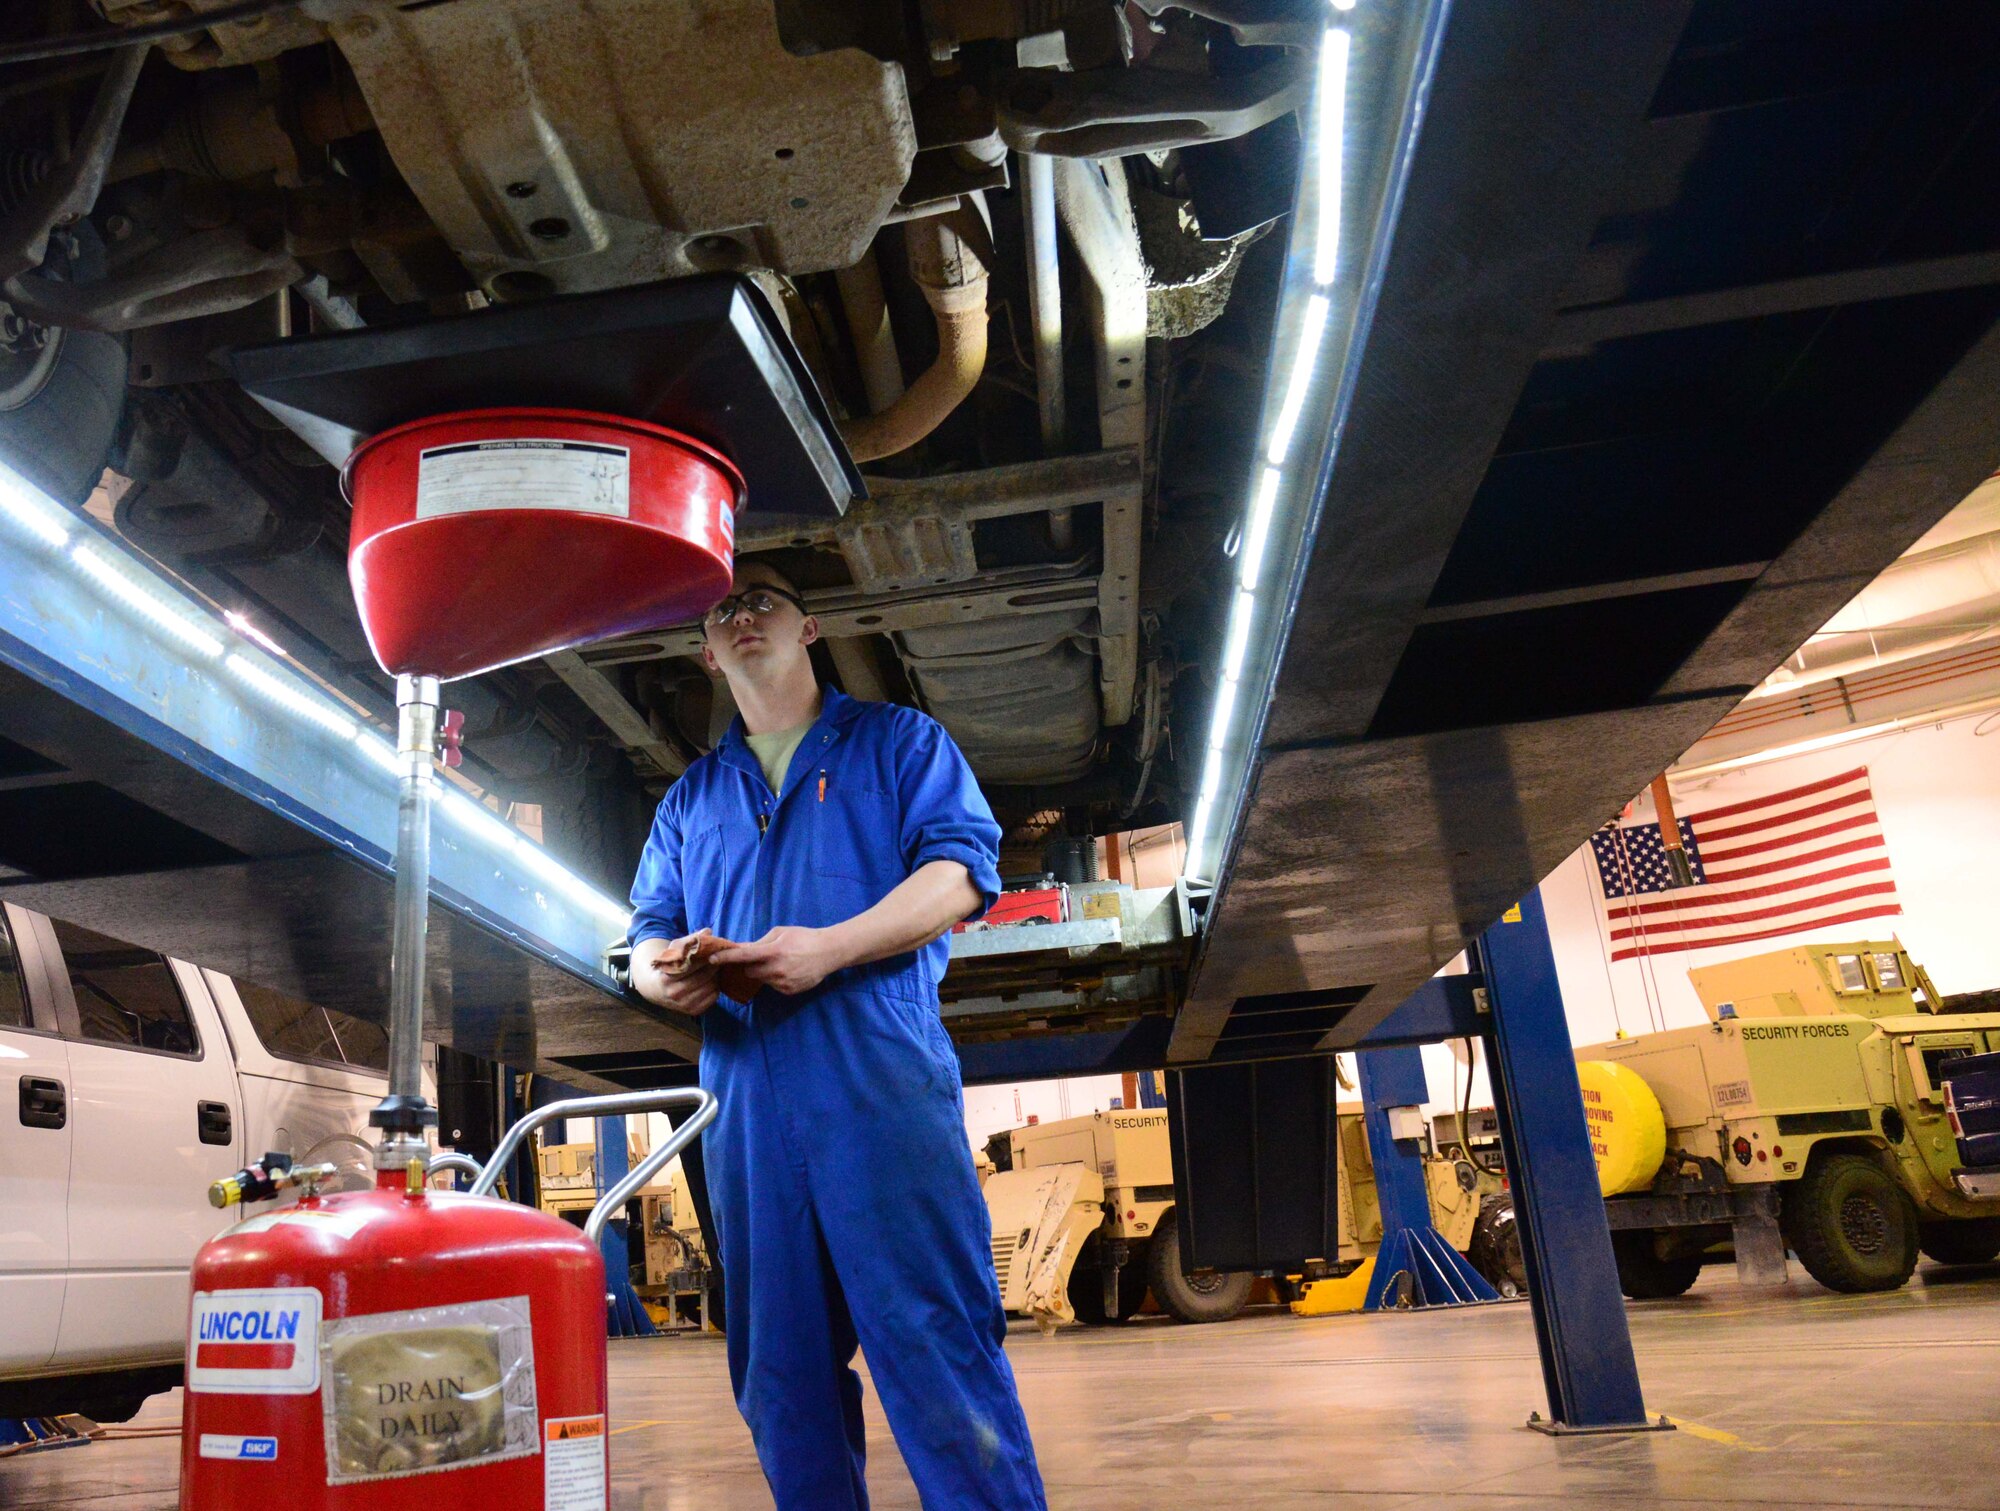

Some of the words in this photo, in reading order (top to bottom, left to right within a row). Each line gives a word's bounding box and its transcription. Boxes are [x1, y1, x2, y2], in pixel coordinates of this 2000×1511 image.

[479, 442, 515, 450] OPERATING
[516, 441, 564, 450] INSTRUCTIONS
[1742, 1026, 1798, 1040] SECURITY
[1802, 1024, 1849, 1038] FORCES
[1582, 1089, 1601, 1103] TION
[1114, 1116, 1168, 1129] SECURITY
[1592, 1142, 1608, 1157] ACK
[200, 1310, 300, 1340] LINCOLN
[377, 1376, 464, 1405] DRAIN
[380, 1411, 464, 1439] DAILY
[245, 1442, 272, 1454] SKF
